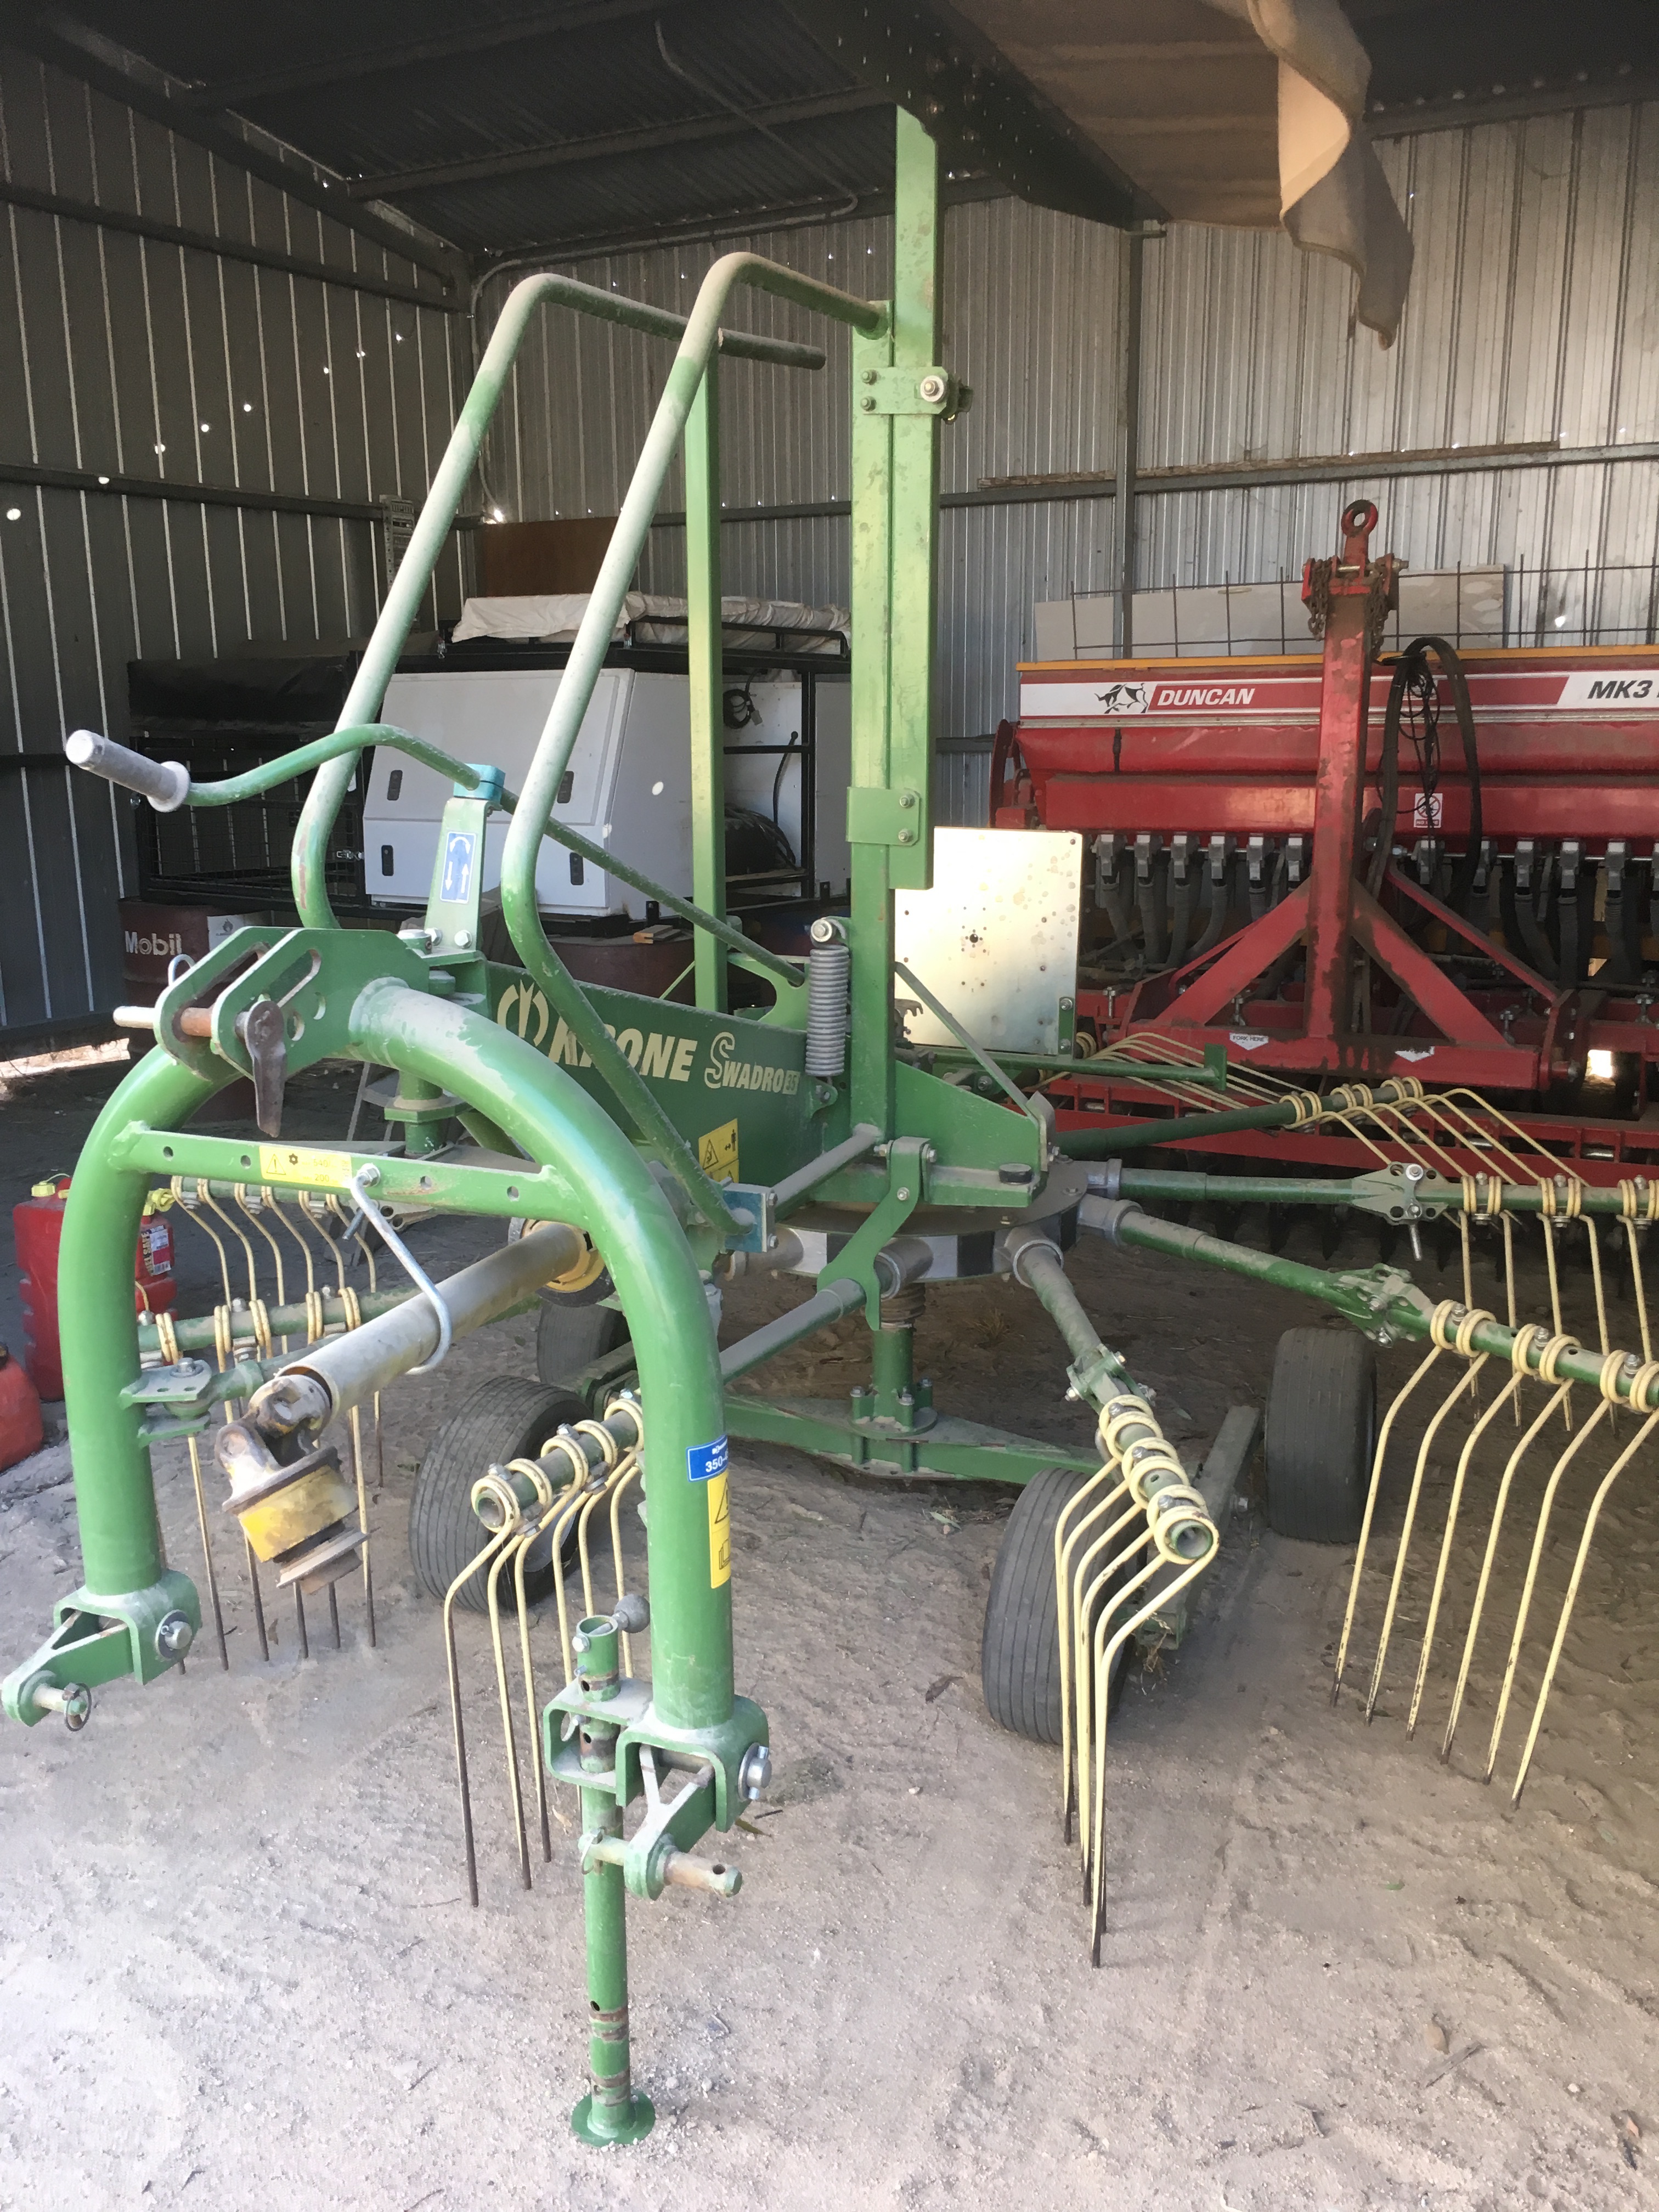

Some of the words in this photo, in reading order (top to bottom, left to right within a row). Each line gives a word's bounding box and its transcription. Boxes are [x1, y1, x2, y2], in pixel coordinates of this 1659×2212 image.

[1157, 688, 1255, 707] DUNCAN
[1587, 680, 1653, 699] MK3
[125, 930, 182, 956] Mobil
[314, 1173, 330, 1182] 200
